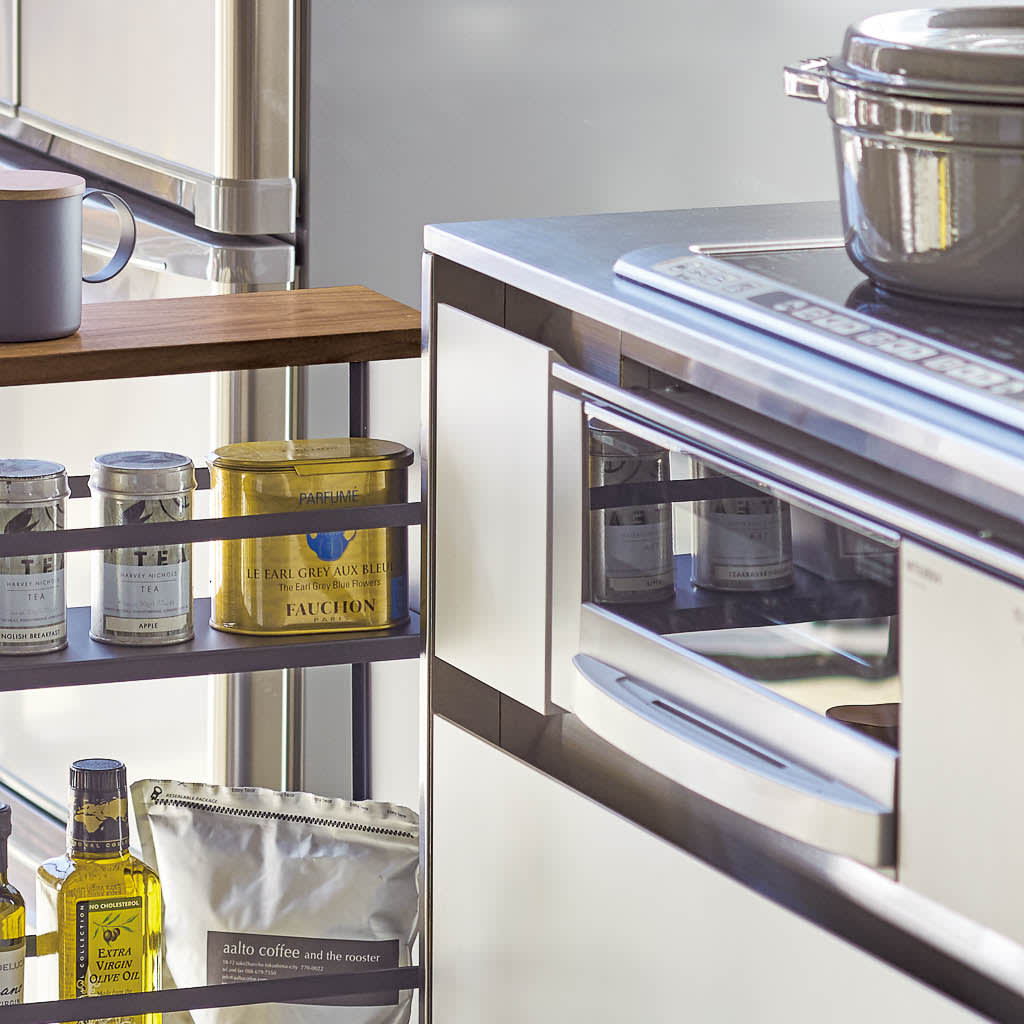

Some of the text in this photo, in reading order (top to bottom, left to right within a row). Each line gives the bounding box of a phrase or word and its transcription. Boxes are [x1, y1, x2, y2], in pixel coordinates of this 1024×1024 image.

[247, 568, 261, 579] LE
[265, 567, 294, 579] EARL
[298, 566, 330, 578] GREY
[333, 564, 358, 577] AUX
[141, 585, 160, 593] TEA
[279, 578, 381, 592] The Earl Grey Blue Flowers
[286, 598, 376, 617] FAUCHON
[138, 622, 159, 630] APPLE
[29, 629, 61, 639] BREAKFAST
[100, 900, 140, 909] CHOLESTEROL
[98, 947, 132, 959] EXTRA
[223, 940, 381, 963] aalto coffee and the rooster
[96, 960, 133, 971] VIRGIN
[90, 971, 140, 984] OLIVE OIL
